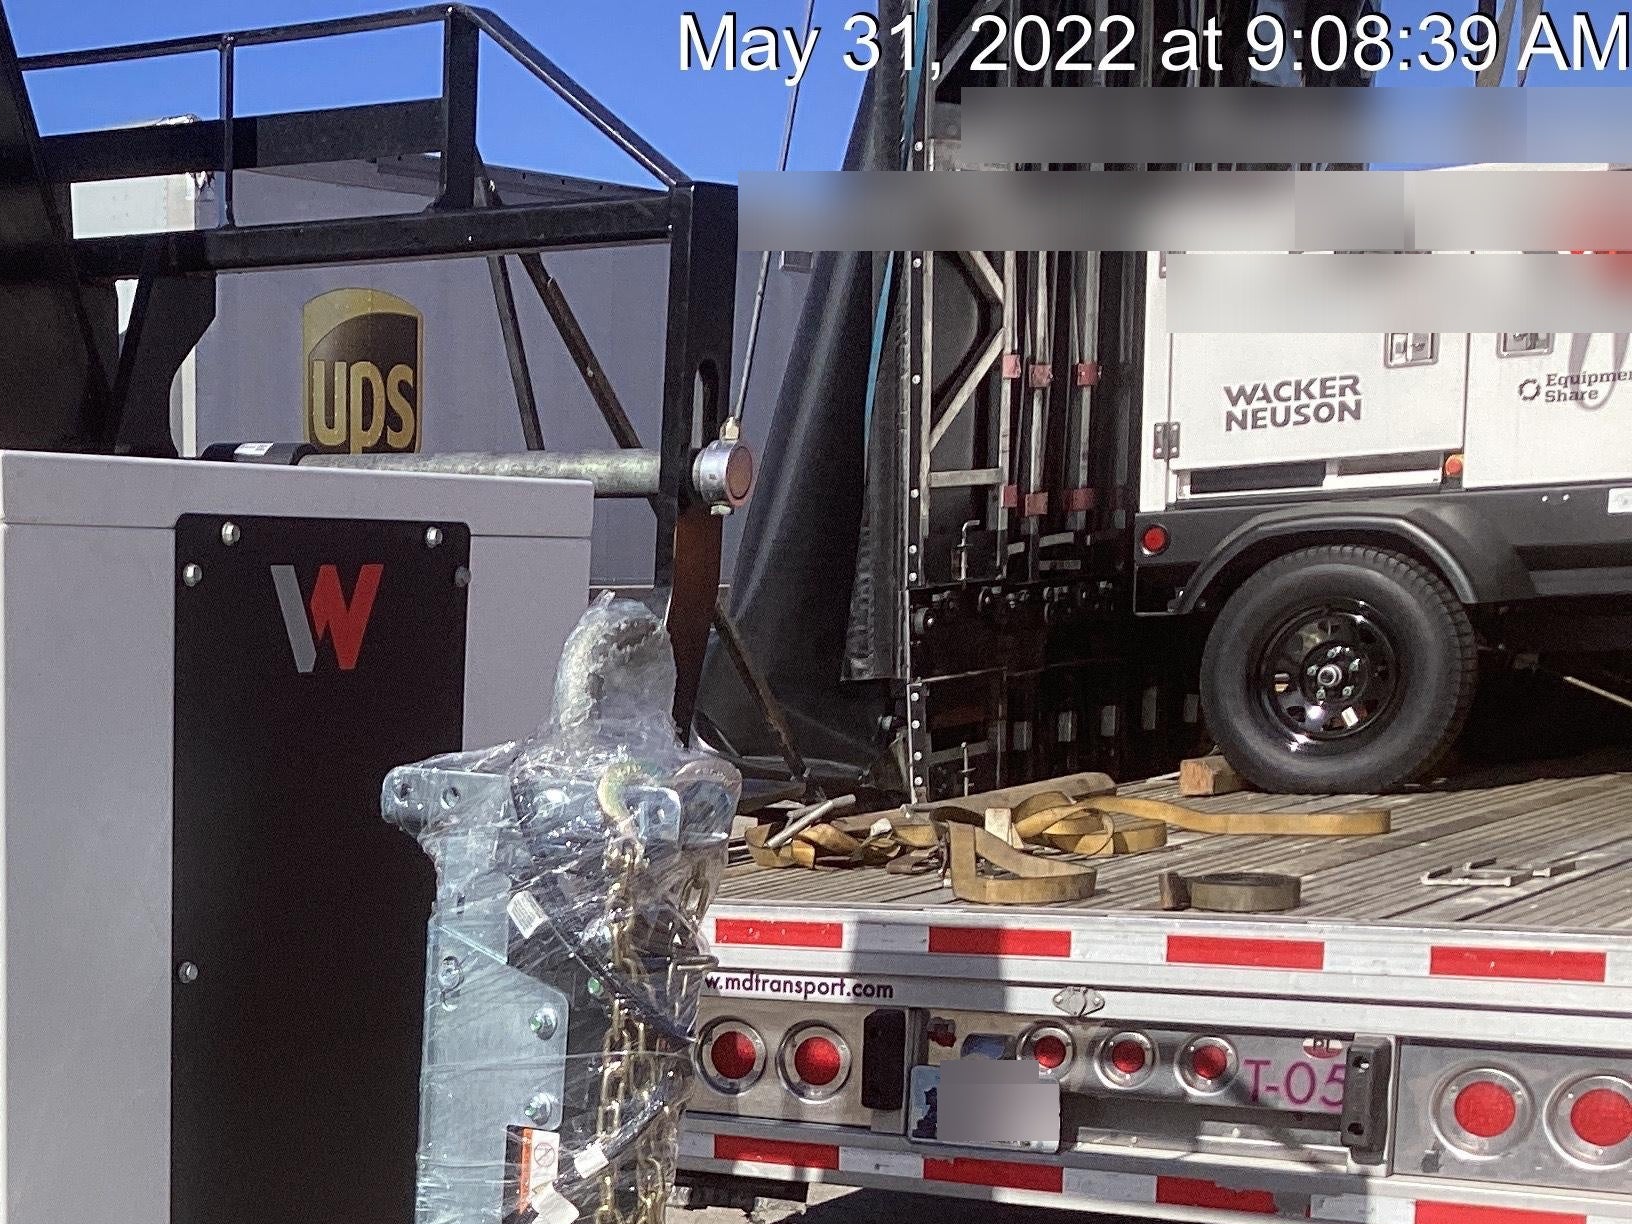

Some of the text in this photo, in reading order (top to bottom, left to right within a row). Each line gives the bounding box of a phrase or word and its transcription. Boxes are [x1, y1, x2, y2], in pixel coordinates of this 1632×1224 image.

[1223, 374, 1362, 408] WACKER
[1545, 388, 1599, 403] Share
[1225, 399, 1362, 433] NEUSON
[1243, 1058, 1346, 1107] T-05
